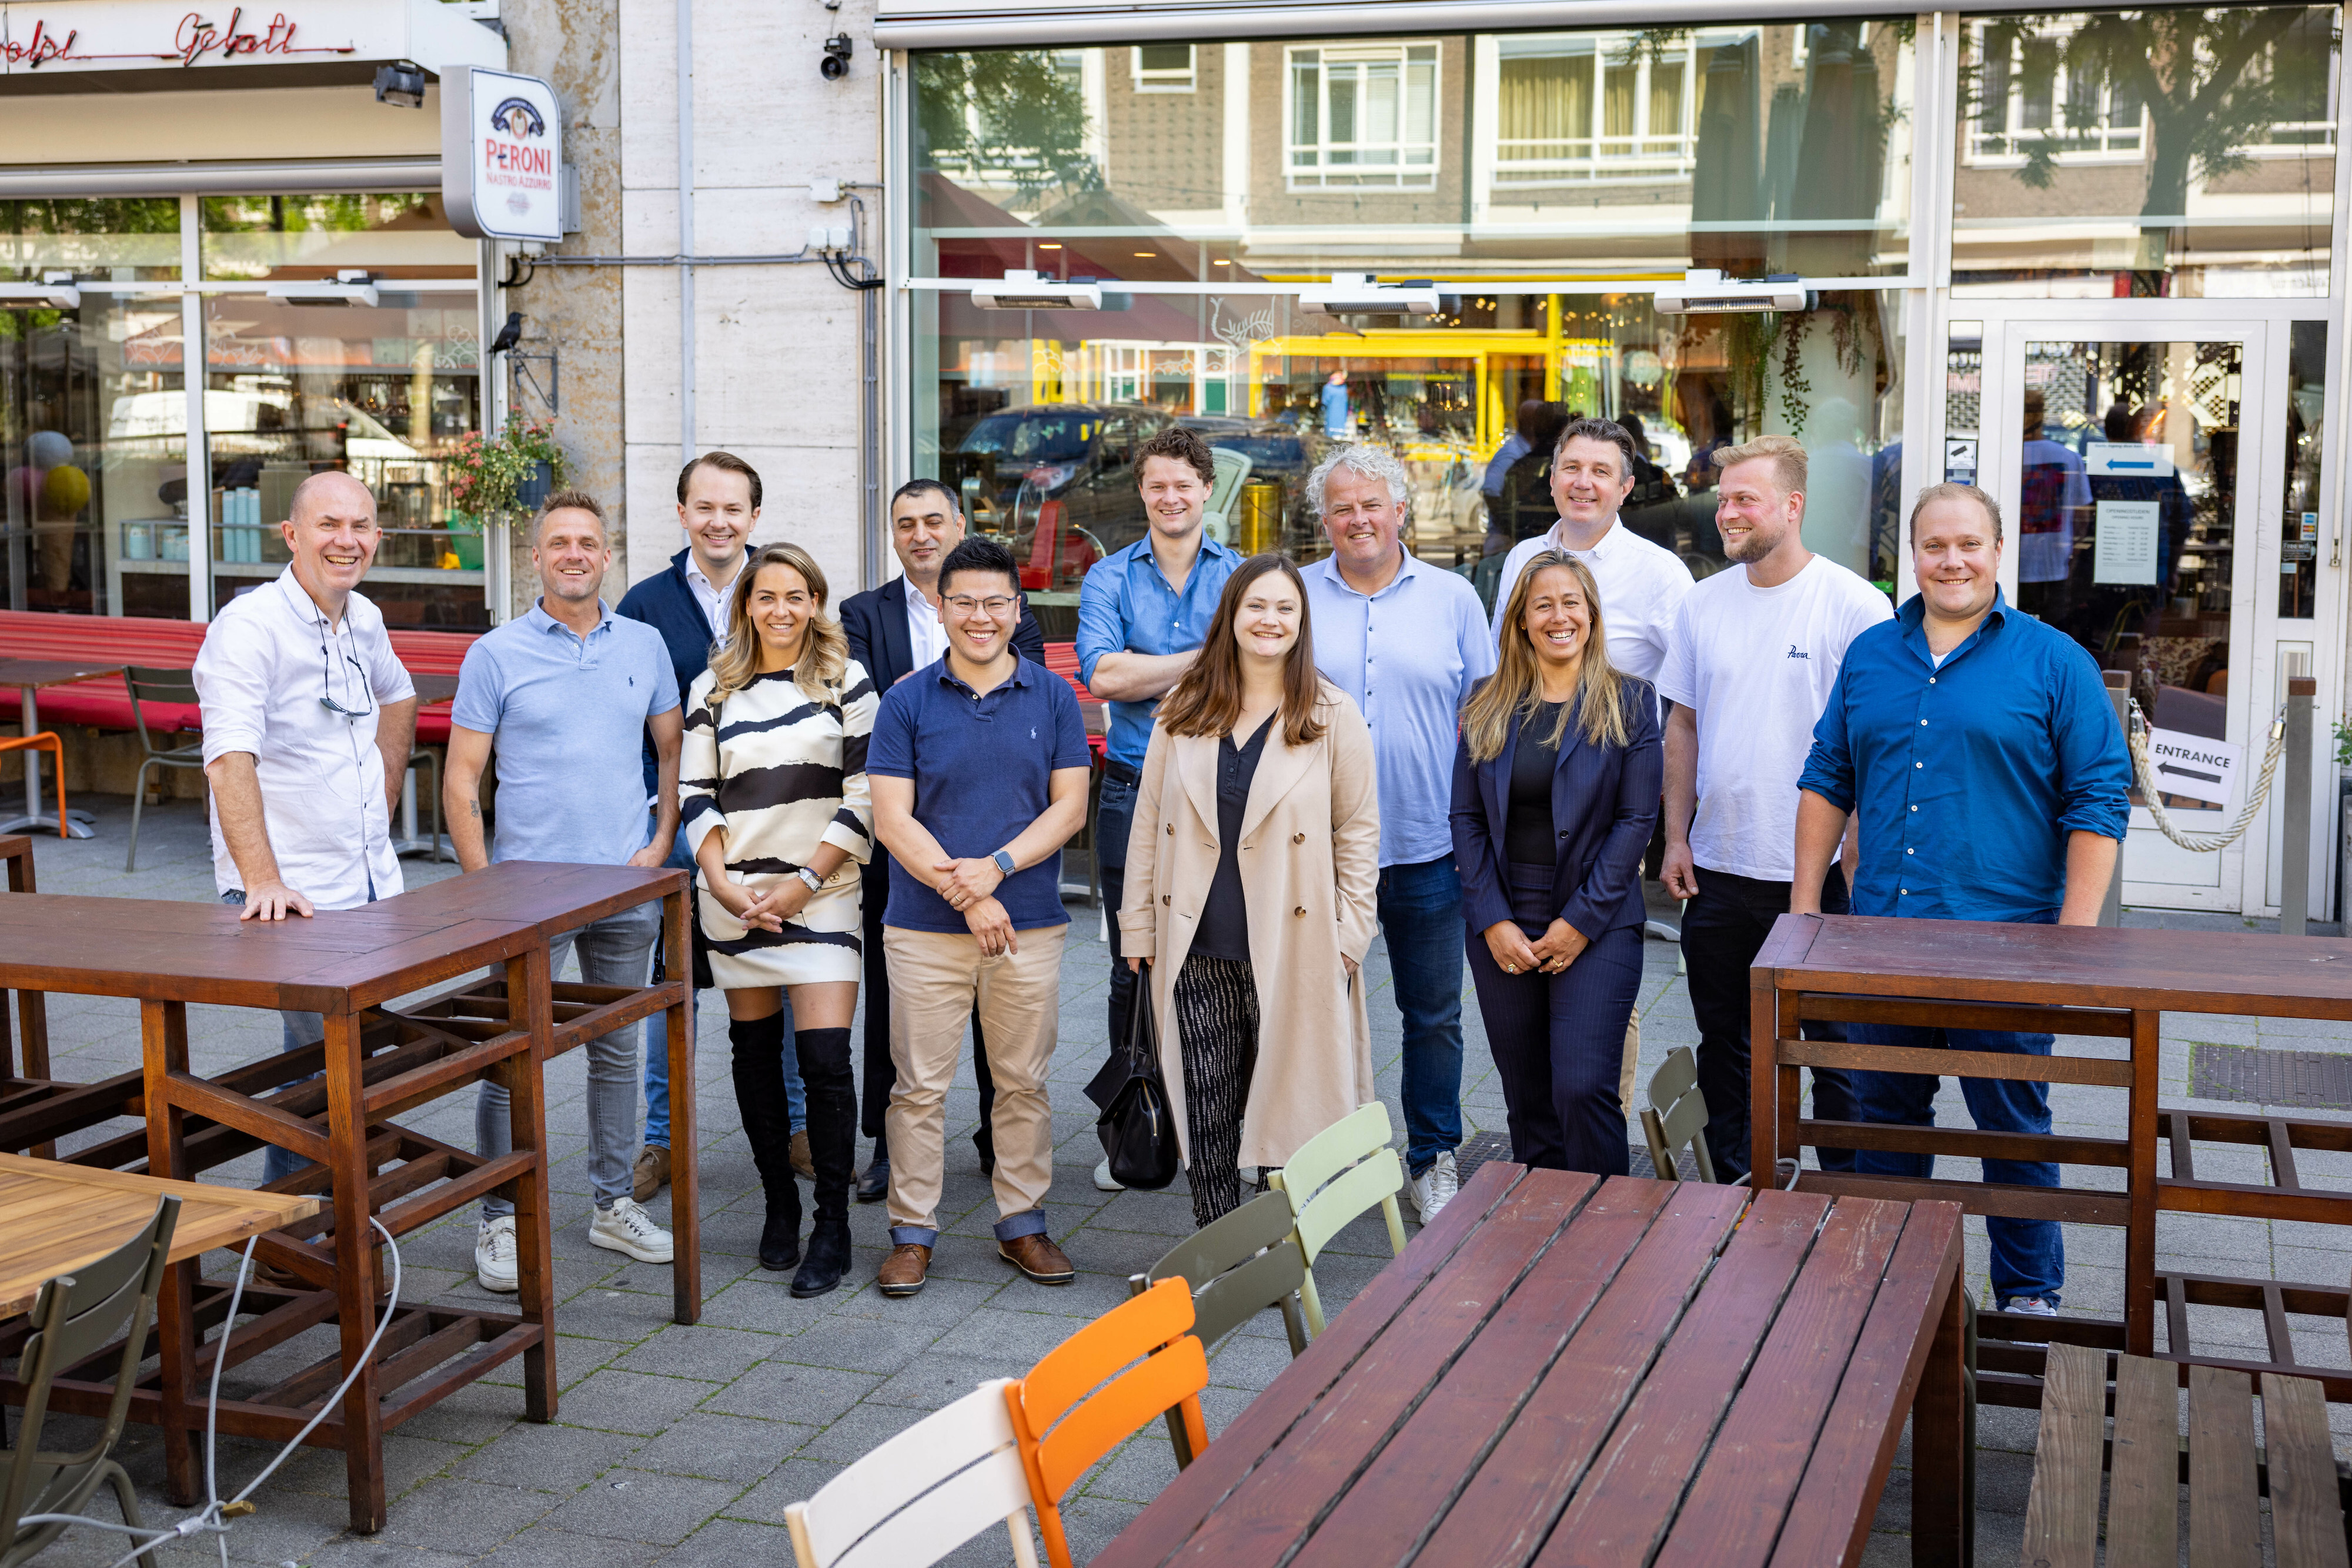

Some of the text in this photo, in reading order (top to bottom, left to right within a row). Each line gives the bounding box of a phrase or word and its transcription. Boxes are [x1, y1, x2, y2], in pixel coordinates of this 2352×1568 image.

[486, 138, 551, 175] PERONI
[486, 172, 552, 190] NASTRO AZZURRO
[1788, 644, 1812, 659] Parra
[2155, 744, 2230, 768] ENTRANCE
